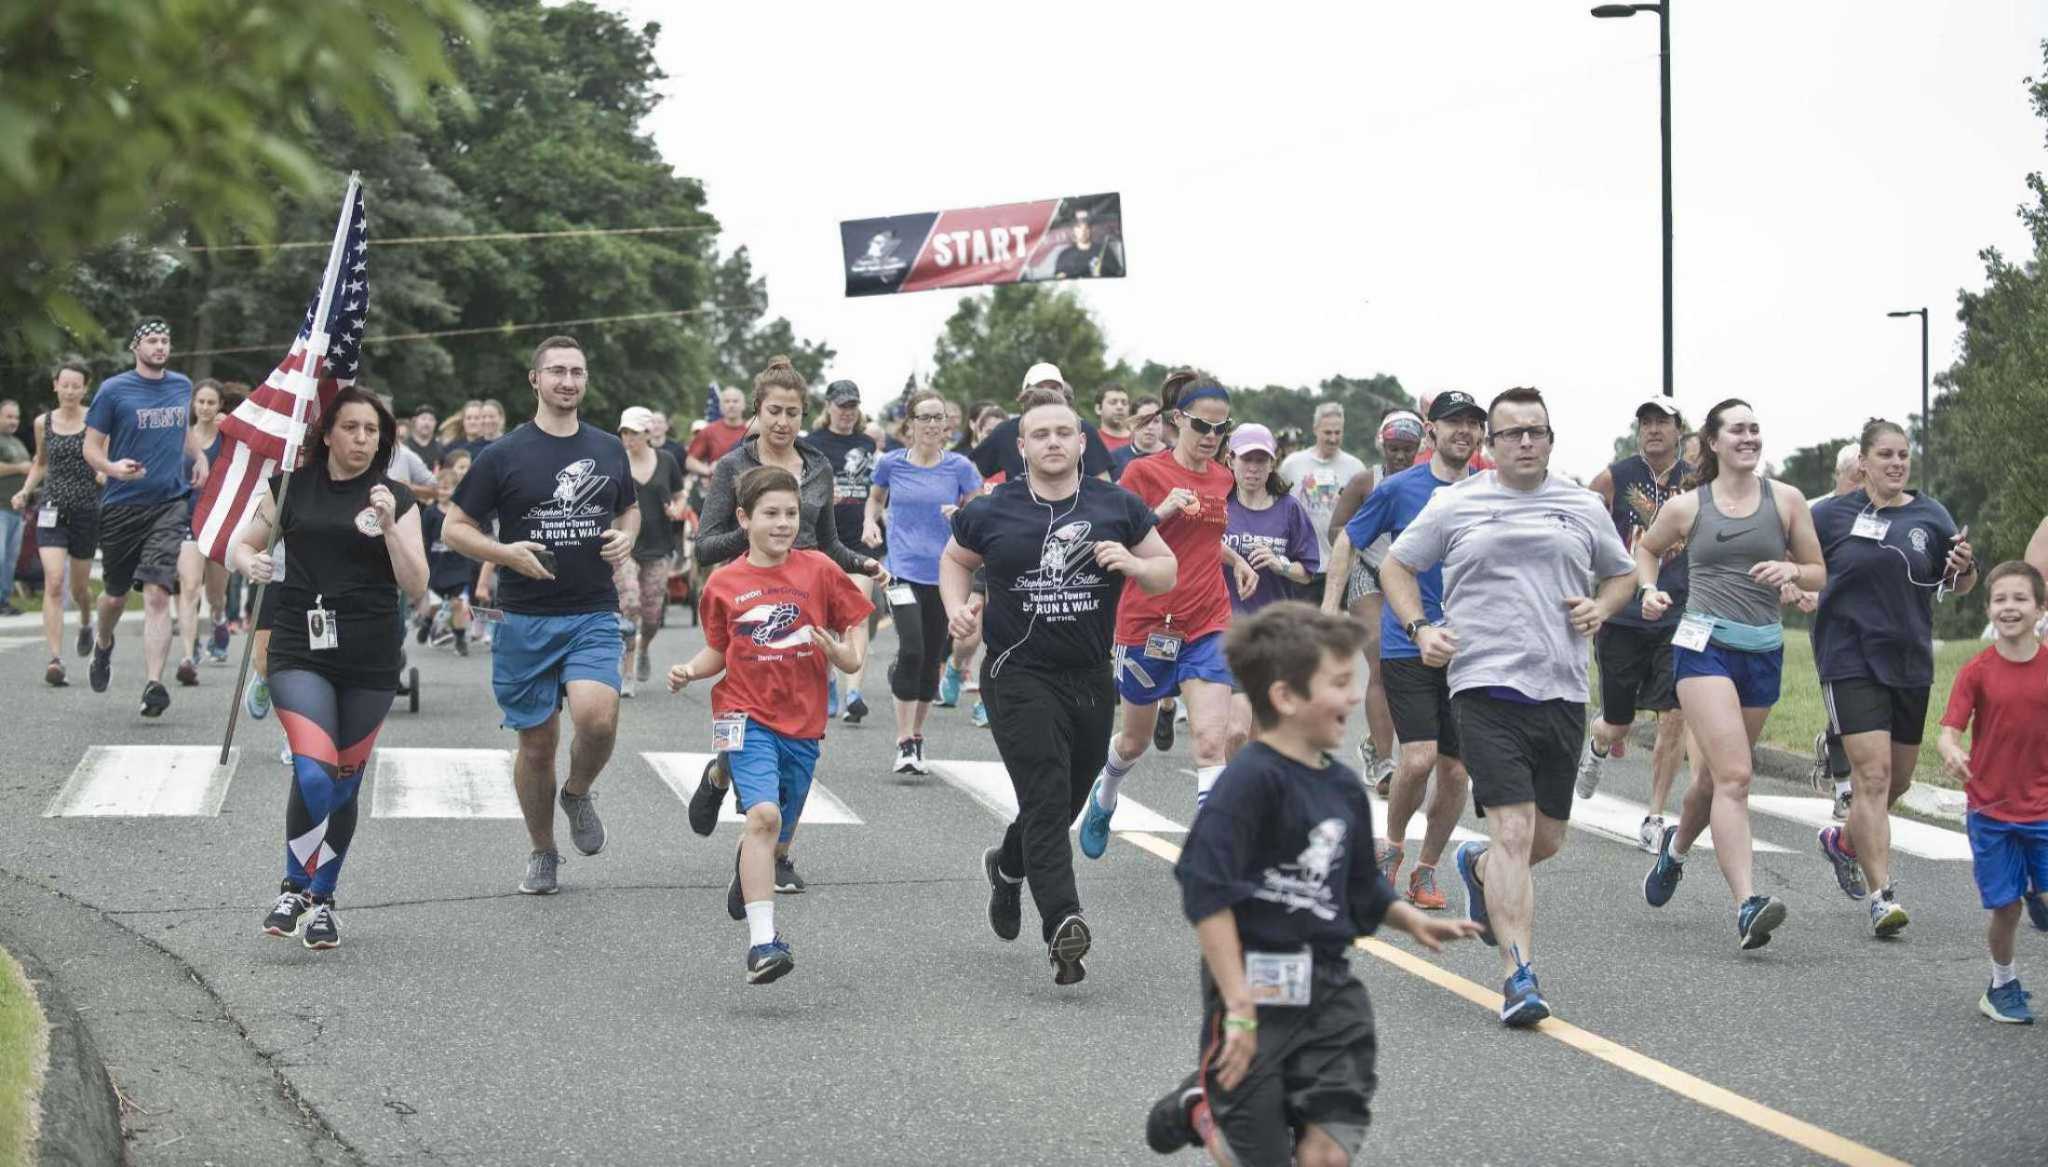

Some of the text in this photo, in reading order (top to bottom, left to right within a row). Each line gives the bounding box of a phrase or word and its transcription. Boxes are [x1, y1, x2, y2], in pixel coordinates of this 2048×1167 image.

[932, 226, 1030, 267] START
[136, 406, 186, 429] FDNY
[541, 520, 565, 529] Tunnel
[571, 519, 595, 528] Towers
[530, 529, 543, 539] 5K
[545, 529, 567, 539] RUN
[569, 529, 576, 538] &
[1014, 576, 1054, 589] Stephen
[1063, 591, 1091, 600] Towers
[1036, 602, 1060, 614] RUN
[1062, 602, 1070, 613] &
[1071, 600, 1100, 612] WALK
